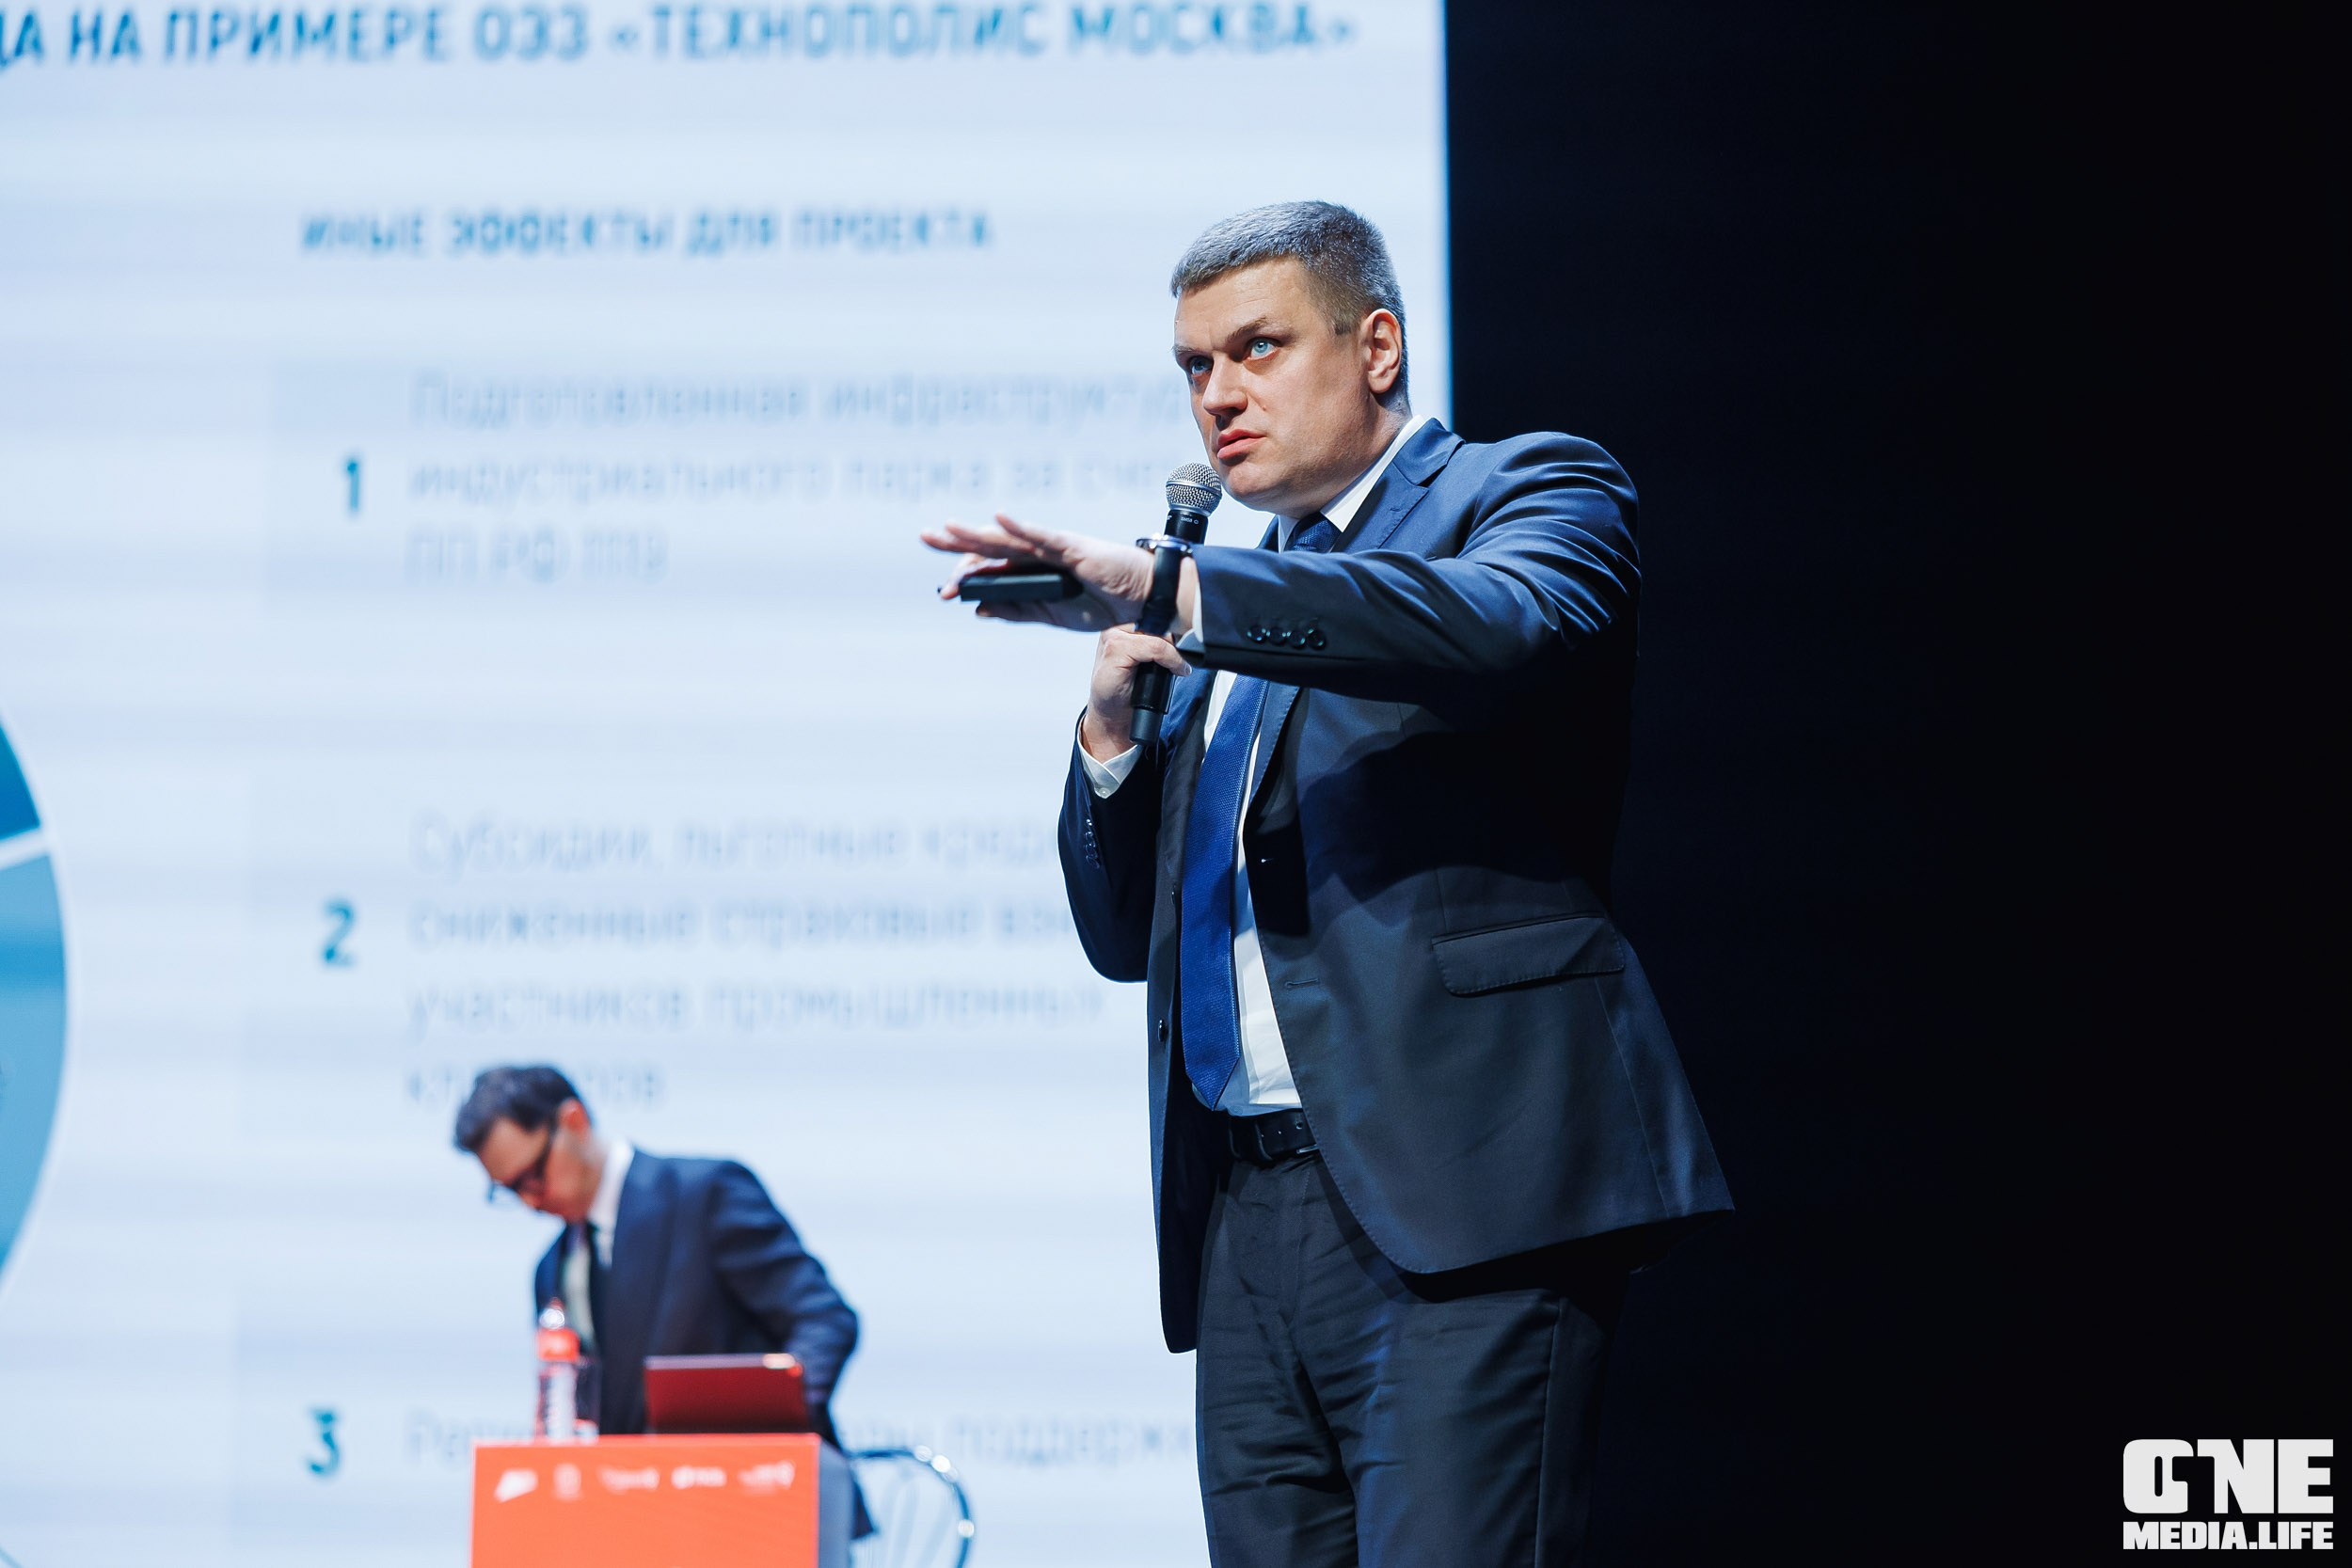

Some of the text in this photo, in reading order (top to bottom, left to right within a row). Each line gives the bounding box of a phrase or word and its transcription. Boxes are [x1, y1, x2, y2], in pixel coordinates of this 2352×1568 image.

[67, 8, 141, 66] НА
[163, 8, 455, 64] ПРИМЕРЕ
[608, 2, 1048, 59] «ТЕХНОПОЛИС
[1066, 2, 1357, 56] МОСКВА»
[299, 206, 993, 257] ИНЫЕ ЭФФЕКТЫ ДЛЯ ПРОЕКТА
[822, 372, 1187, 432] инфраструктур
[341, 455, 364, 515] 1
[320, 896, 358, 968] 2
[305, 1408, 342, 1479] 3
